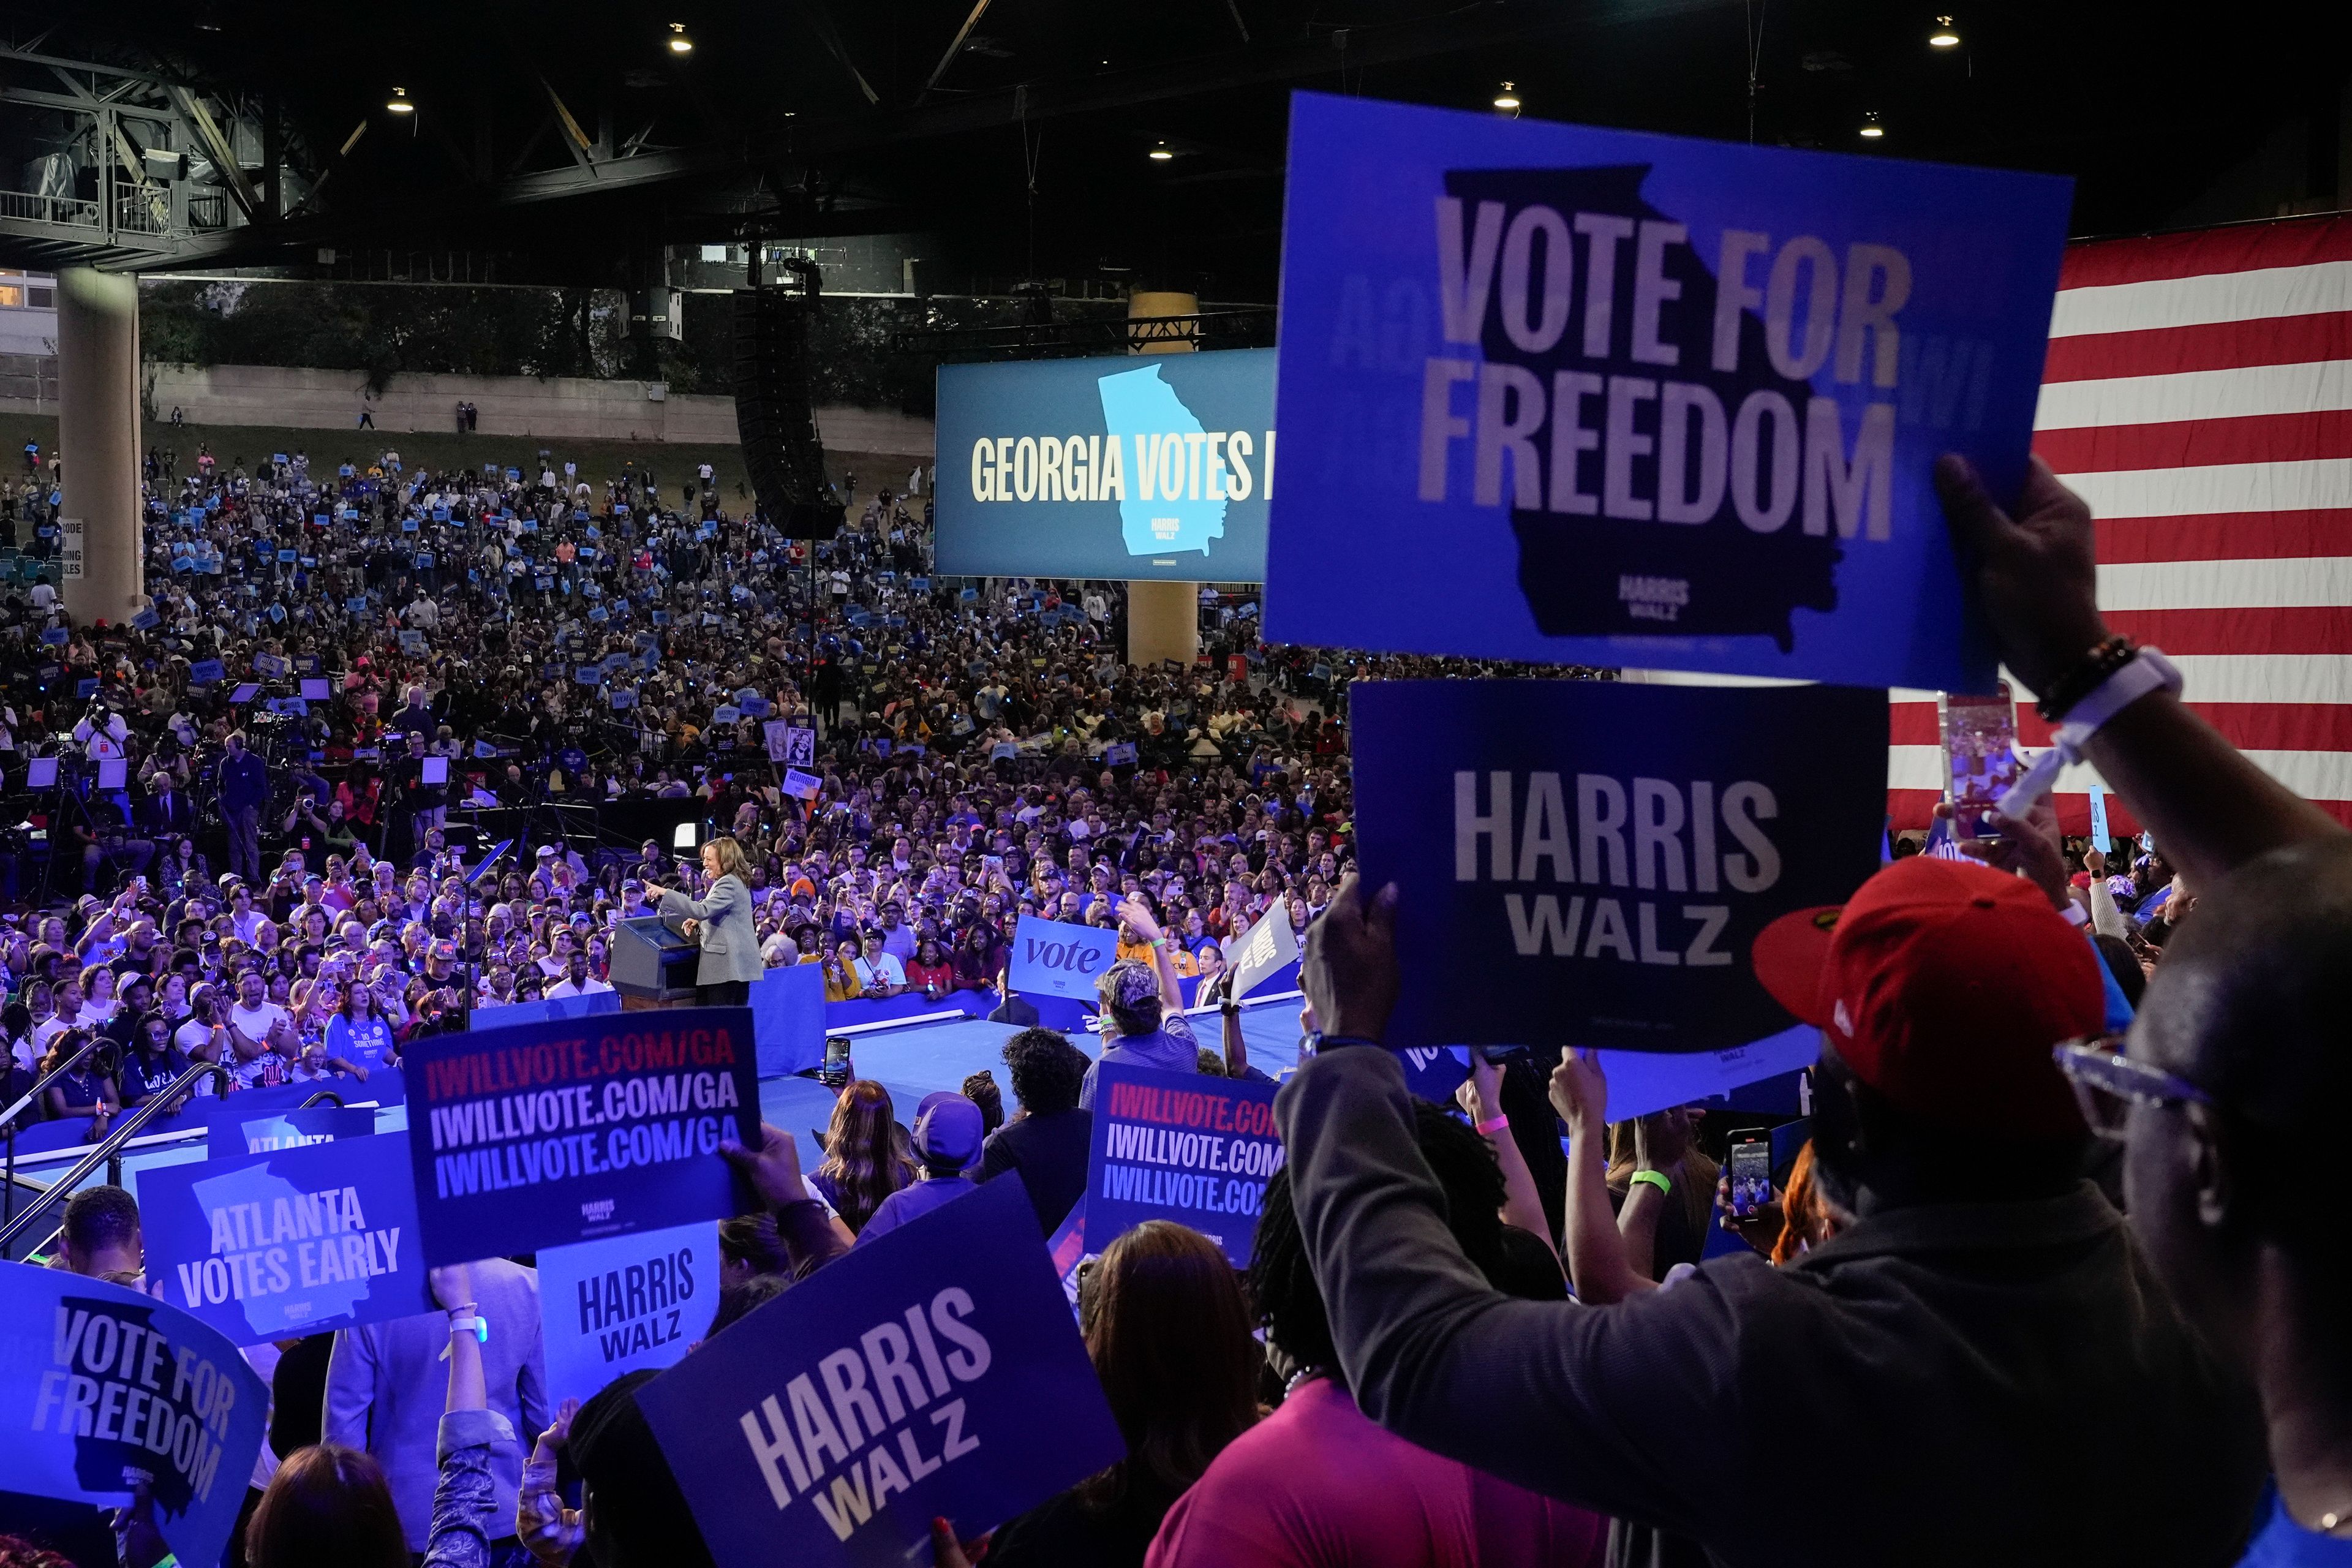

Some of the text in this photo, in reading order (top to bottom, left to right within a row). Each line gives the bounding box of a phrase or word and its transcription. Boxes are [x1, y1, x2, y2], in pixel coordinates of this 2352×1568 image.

[1435, 197, 1689, 366] VOTE
[1711, 228, 1913, 388] FOR
[971, 435, 1125, 502] GEORGIA
[1136, 431, 1253, 501] VOTES
[1418, 357, 1896, 542] FREEDOM
[1152, 518, 1179, 531] HARRIS
[1618, 575, 1690, 606] HARRIS
[790, 772, 816, 787] GEORGIA
[1454, 771, 1782, 893] HARRIS
[1026, 938, 1101, 974] vote
[1506, 893, 1732, 967] WALZ
[354, 1038, 385, 1048] SOMETHING
[425, 1028, 736, 1101] IWILLVOTE.COM/GA
[430, 1071, 739, 1152] IWILLVOTE.COM/GA
[435, 1114, 741, 1200] IWILLVOTE.COM/GA
[211, 1186, 366, 1254] ATLANTA
[582, 1199, 616, 1216] HARRIS
[1199, 1234, 1223, 1246] ARRIS
[177, 1227, 401, 1309] VOTES EARLY
[578, 1248, 695, 1335] HARRIS
[284, 1302, 312, 1316] HARRIS
[600, 1309, 682, 1363] WALZ
[54, 1306, 236, 1443] VOTE FOR
[739, 1286, 992, 1511] HARRIS
[31, 1370, 222, 1505] FREEDOM
[811, 1398, 981, 1543] WALZ
